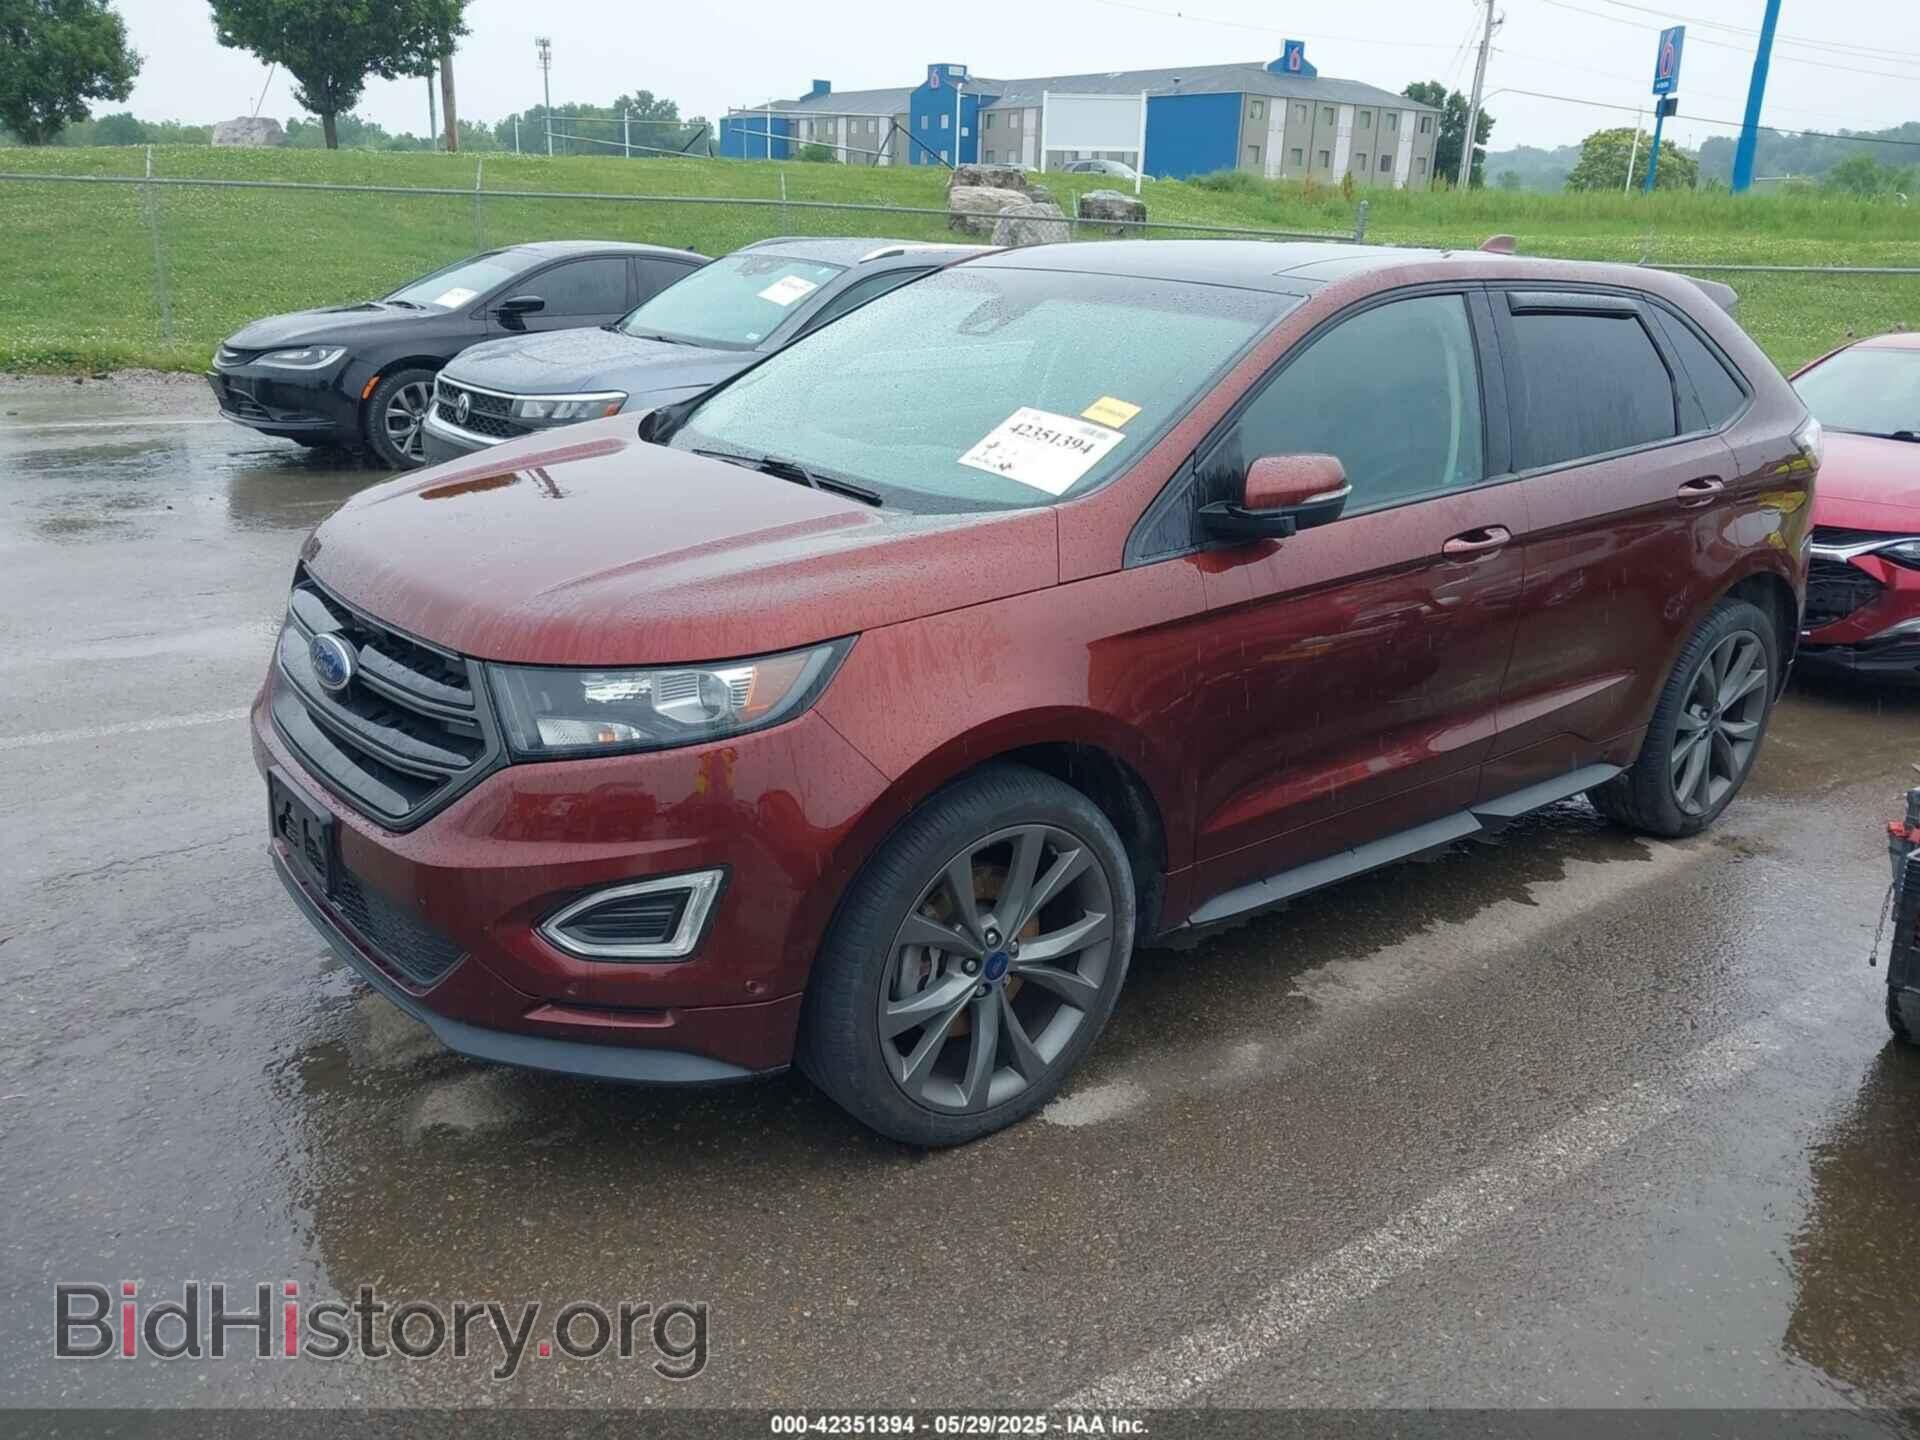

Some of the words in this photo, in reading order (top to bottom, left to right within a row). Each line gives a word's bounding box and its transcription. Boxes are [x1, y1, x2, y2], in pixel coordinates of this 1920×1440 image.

[1289, 46, 1301, 71] 6
[1659, 31, 1674, 79] 6
[1009, 423, 1096, 455] 42351394
